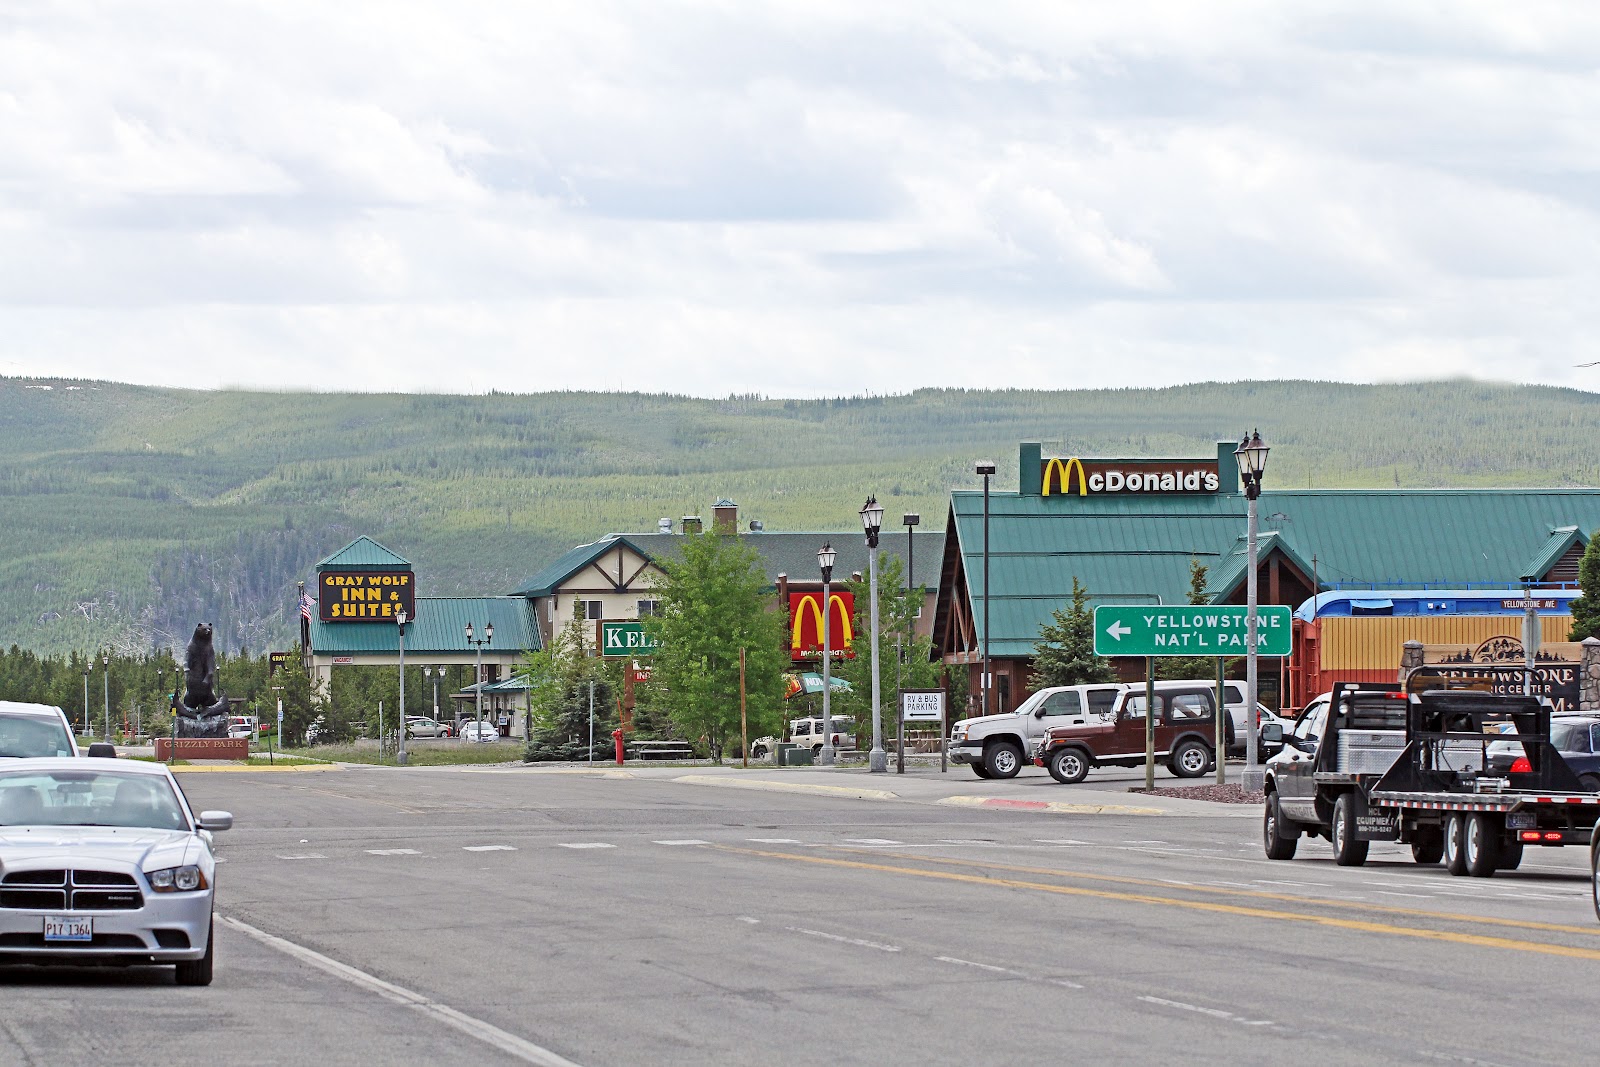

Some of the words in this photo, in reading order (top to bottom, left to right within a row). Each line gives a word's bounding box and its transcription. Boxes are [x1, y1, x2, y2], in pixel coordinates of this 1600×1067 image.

[1042, 457, 1219, 496] McDonald's
[325, 576, 364, 586] GRAY
[368, 576, 408, 586] WOLF
[342, 588, 381, 601] INN
[389, 591, 399, 601] &
[1503, 600, 1540, 608] YELLOWSTONE
[1544, 600, 1555, 608] AVE
[1155, 631, 1208, 646] NAT'L
[1508, 685, 1551, 693] CETER
[907, 695, 915, 703] RV
[917, 695, 923, 703] &
[924, 695, 938, 703] BUS
[163, 741, 212, 749] GRIZZLY
[213, 741, 243, 749] PARK
[46, 924, 63, 935] P17
[68, 924, 90, 935] 1364
